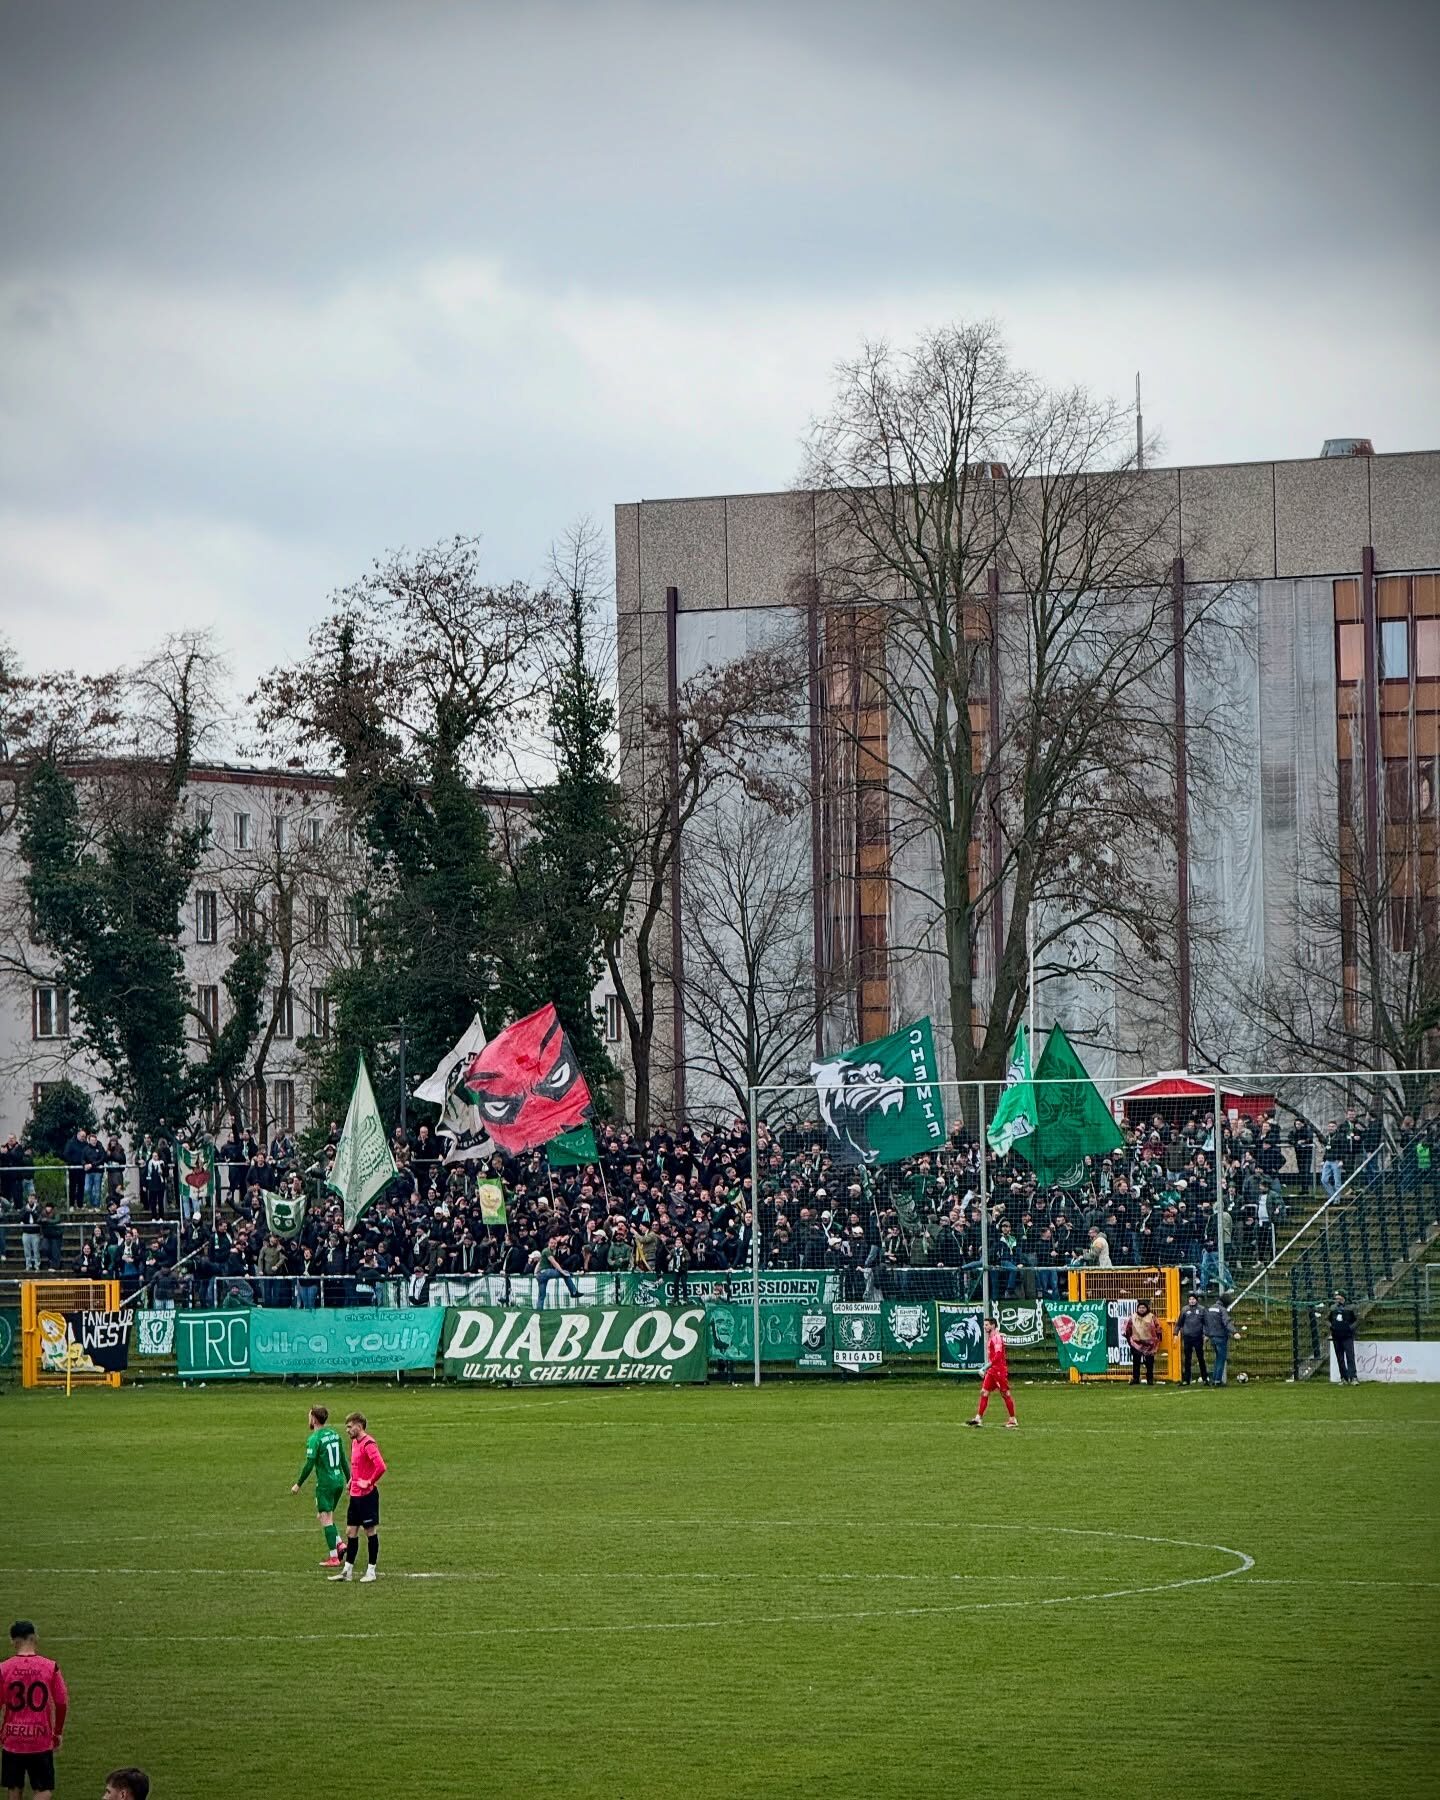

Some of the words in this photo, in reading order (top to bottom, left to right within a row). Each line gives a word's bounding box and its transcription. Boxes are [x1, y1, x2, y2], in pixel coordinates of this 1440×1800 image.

[834, 1304, 853, 1312] GEORG
[1045, 1299, 1106, 1312] Bierstand
[82, 1309, 133, 1326] FANCLUB
[82, 1324, 128, 1349] WEST
[179, 1318, 248, 1367] TRC
[444, 1310, 705, 1361] DIABLOS
[836, 1353, 881, 1361] BRIGADE
[462, 1363, 523, 1380] ULTRAS
[529, 1364, 600, 1381] CHEMIE
[605, 1363, 674, 1380] LEIPZIG
[326, 1441, 341, 1467] 17
[8, 1680, 49, 1712] 30
[7, 1723, 49, 1737] BERLIN
